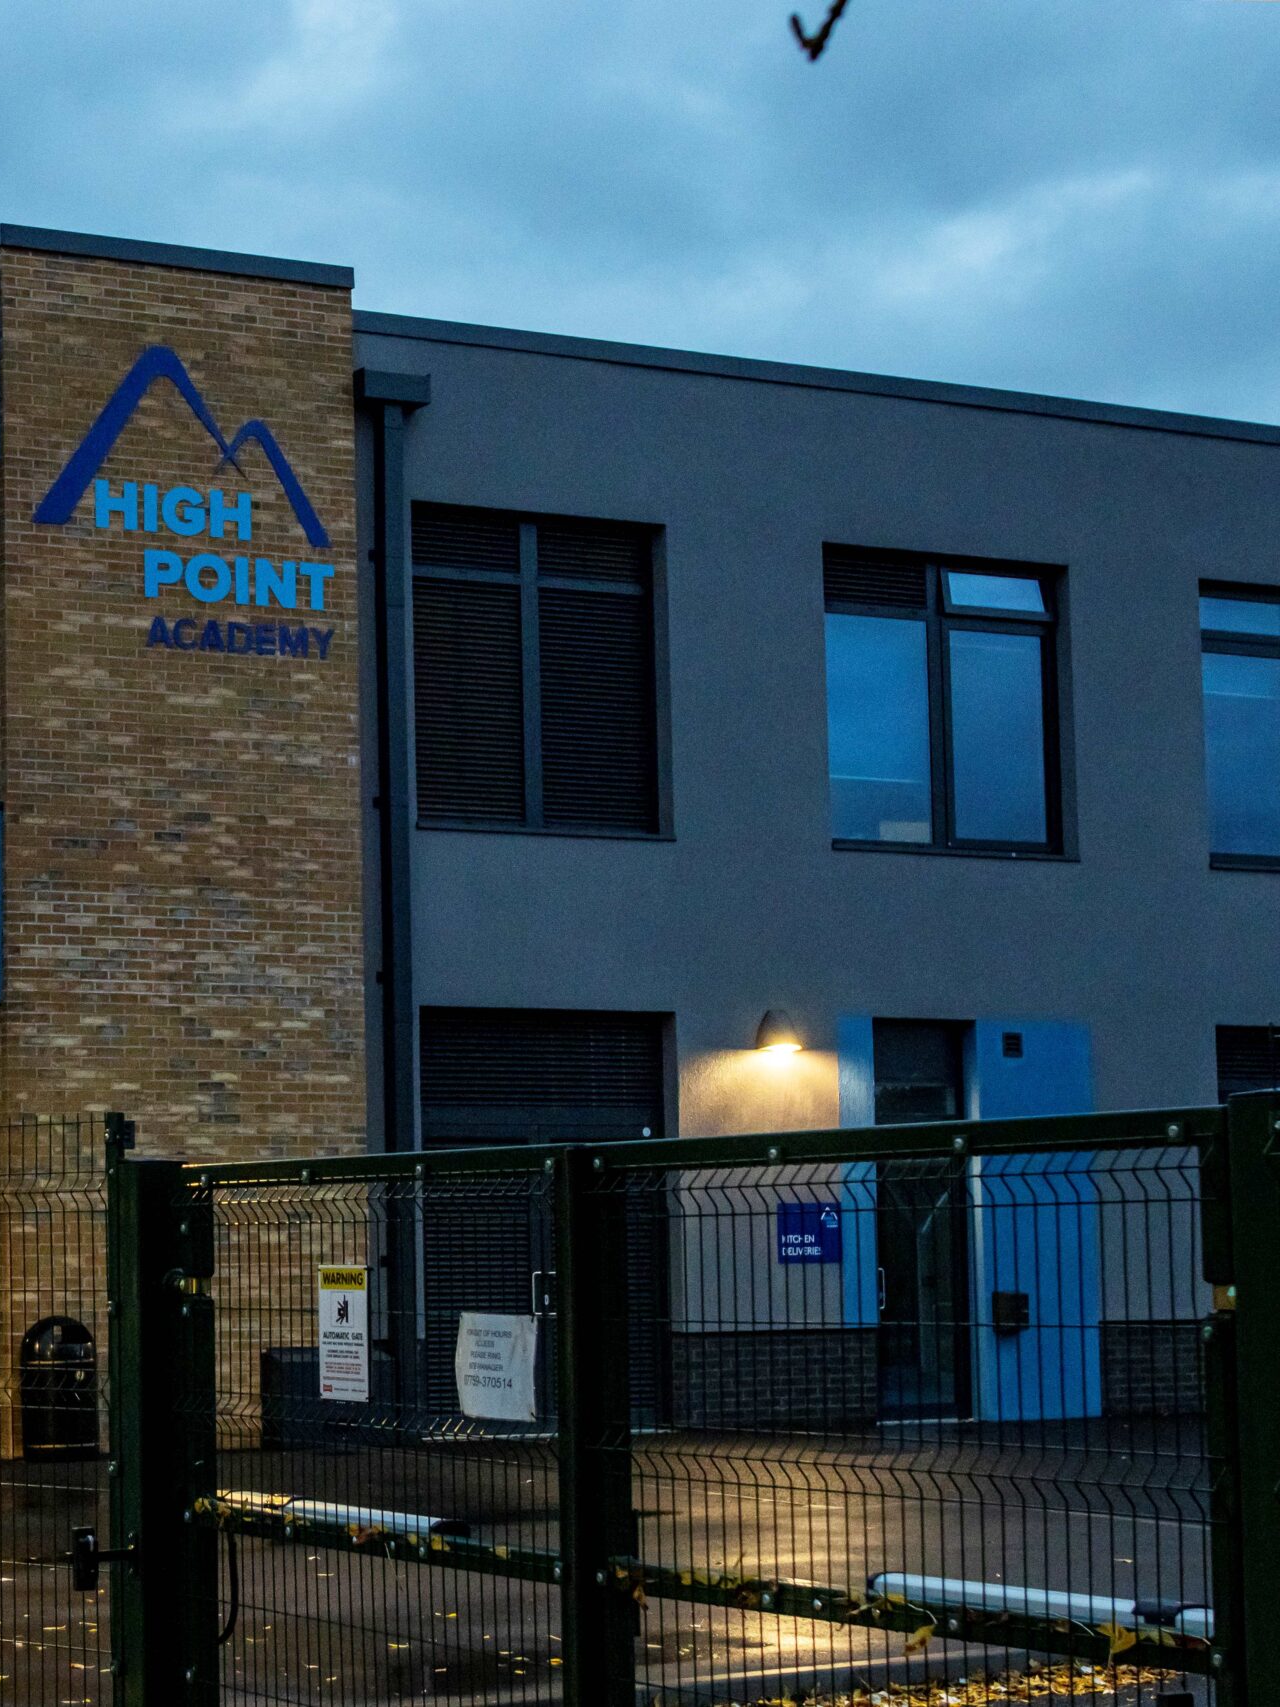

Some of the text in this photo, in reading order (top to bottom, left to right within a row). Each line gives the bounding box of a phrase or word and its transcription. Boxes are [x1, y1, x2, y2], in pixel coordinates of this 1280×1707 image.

[95, 479, 252, 541] HIGH
[144, 549, 335, 611] POINT
[146, 615, 335, 660] ACADEMY
[322, 1271, 363, 1286] WARNING
[322, 1331, 363, 1341] AUTOMATIC GATE
